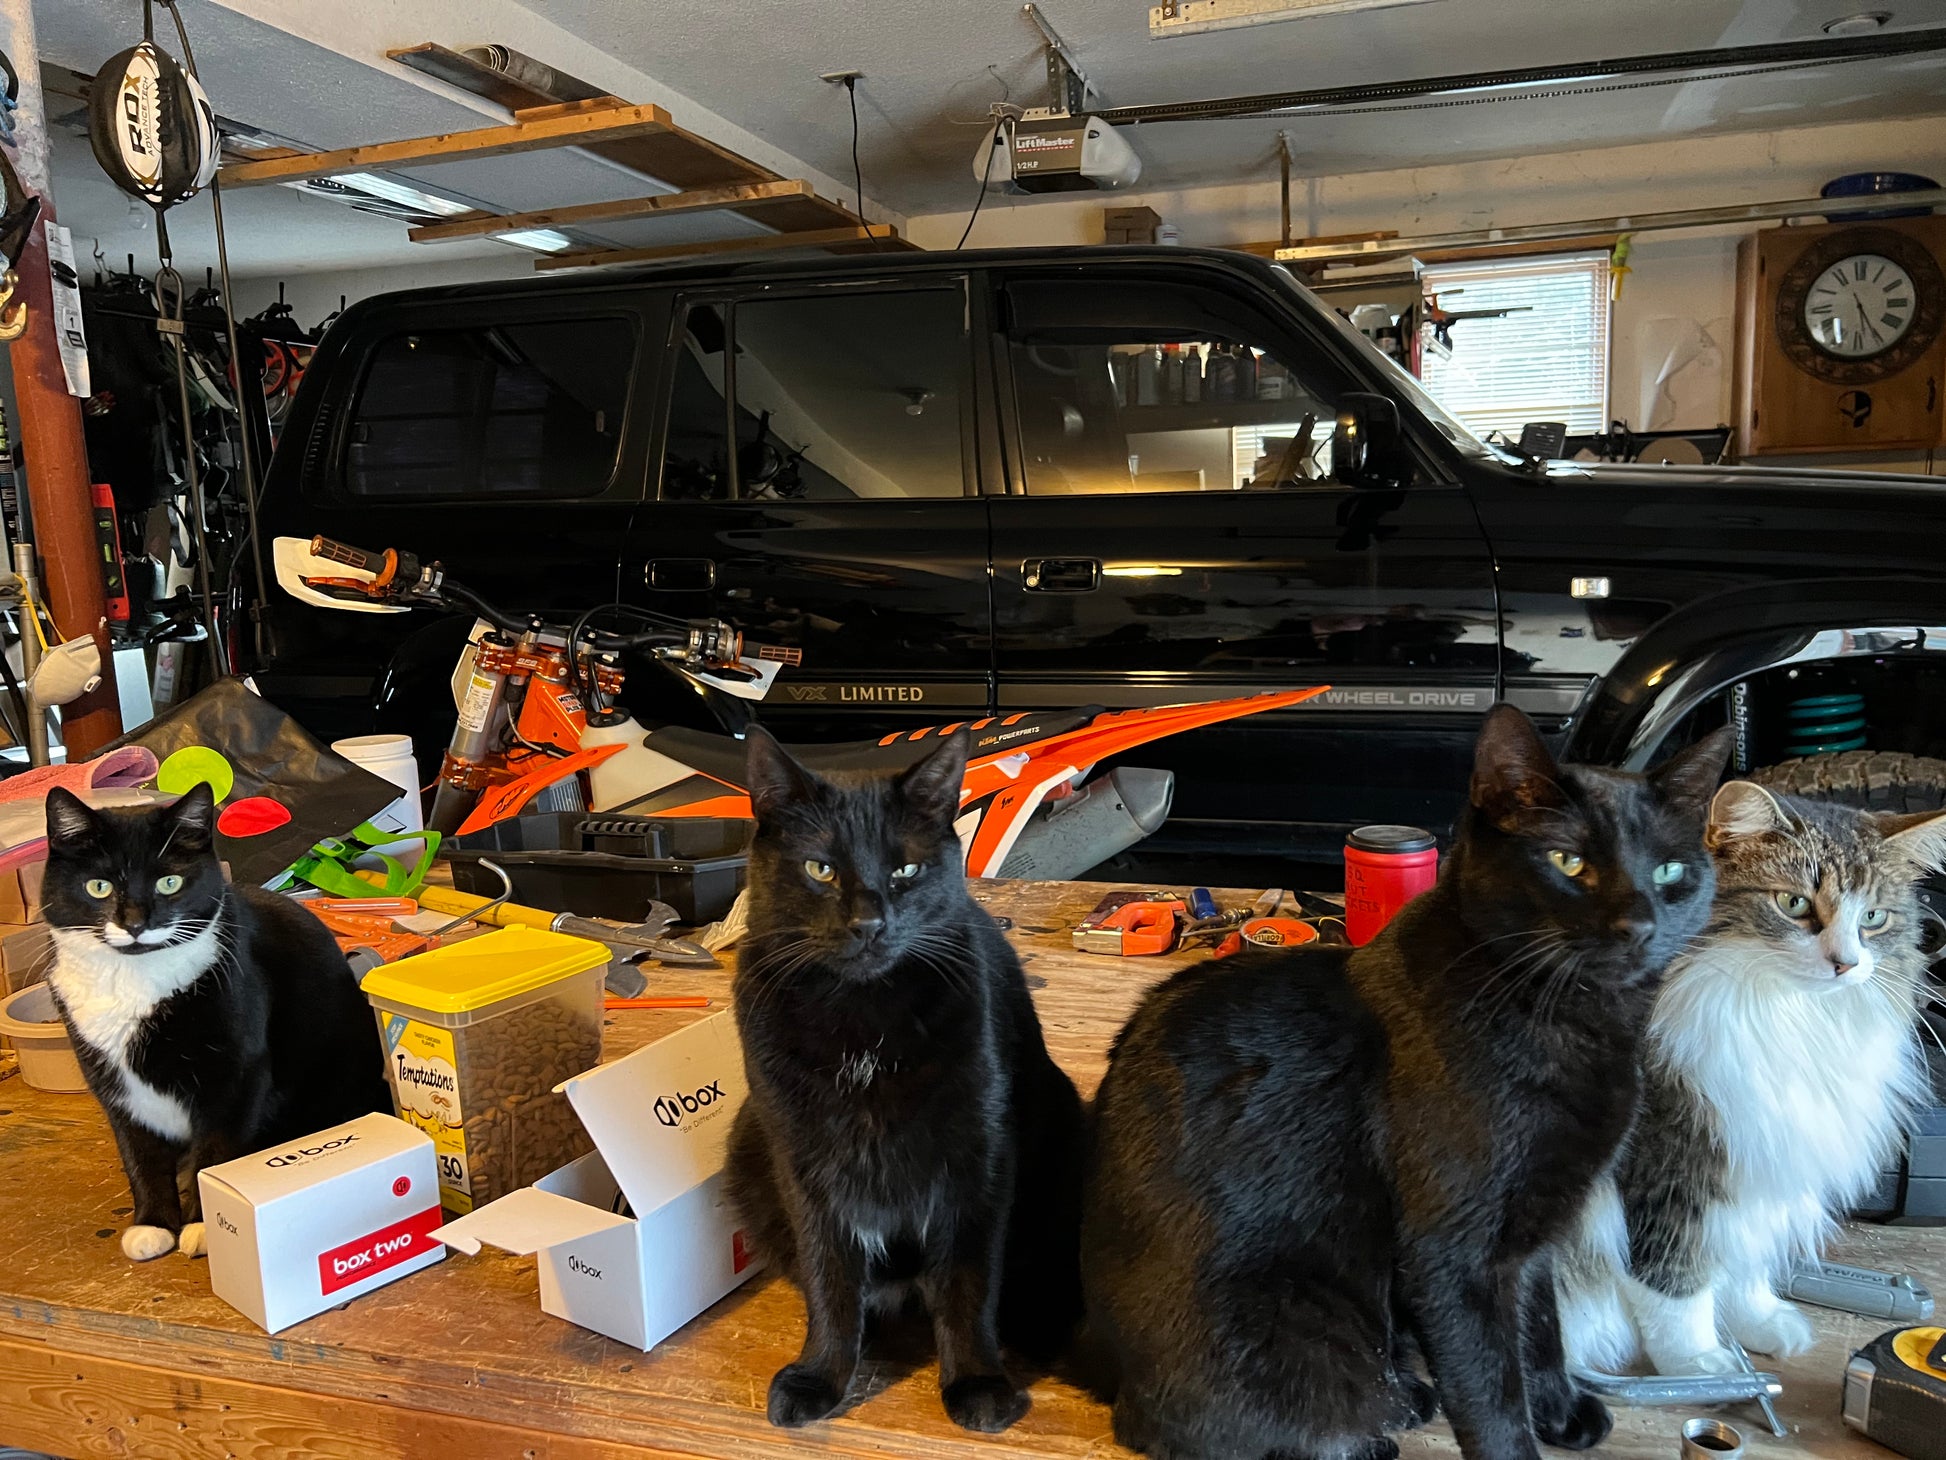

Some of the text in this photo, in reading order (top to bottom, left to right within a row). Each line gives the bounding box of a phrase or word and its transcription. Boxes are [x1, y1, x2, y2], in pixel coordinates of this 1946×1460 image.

[124, 74, 146, 155] RDX
[141, 76, 155, 157] ADVANCE TECH
[1016, 138, 1075, 149] LiftMaster
[787, 686, 924, 702] VX LIMITED
[1325, 691, 1404, 705] WHEEL
[1409, 692, 1476, 706] DRIVE
[1734, 682, 1748, 771] Dobinsons
[397, 1053, 455, 1092] Temptations
[676, 1080, 727, 1114] box
[298, 1134, 361, 1155] box
[440, 1155, 463, 1180] 30
[333, 1233, 412, 1275] box two
[580, 1260, 602, 1280] box
